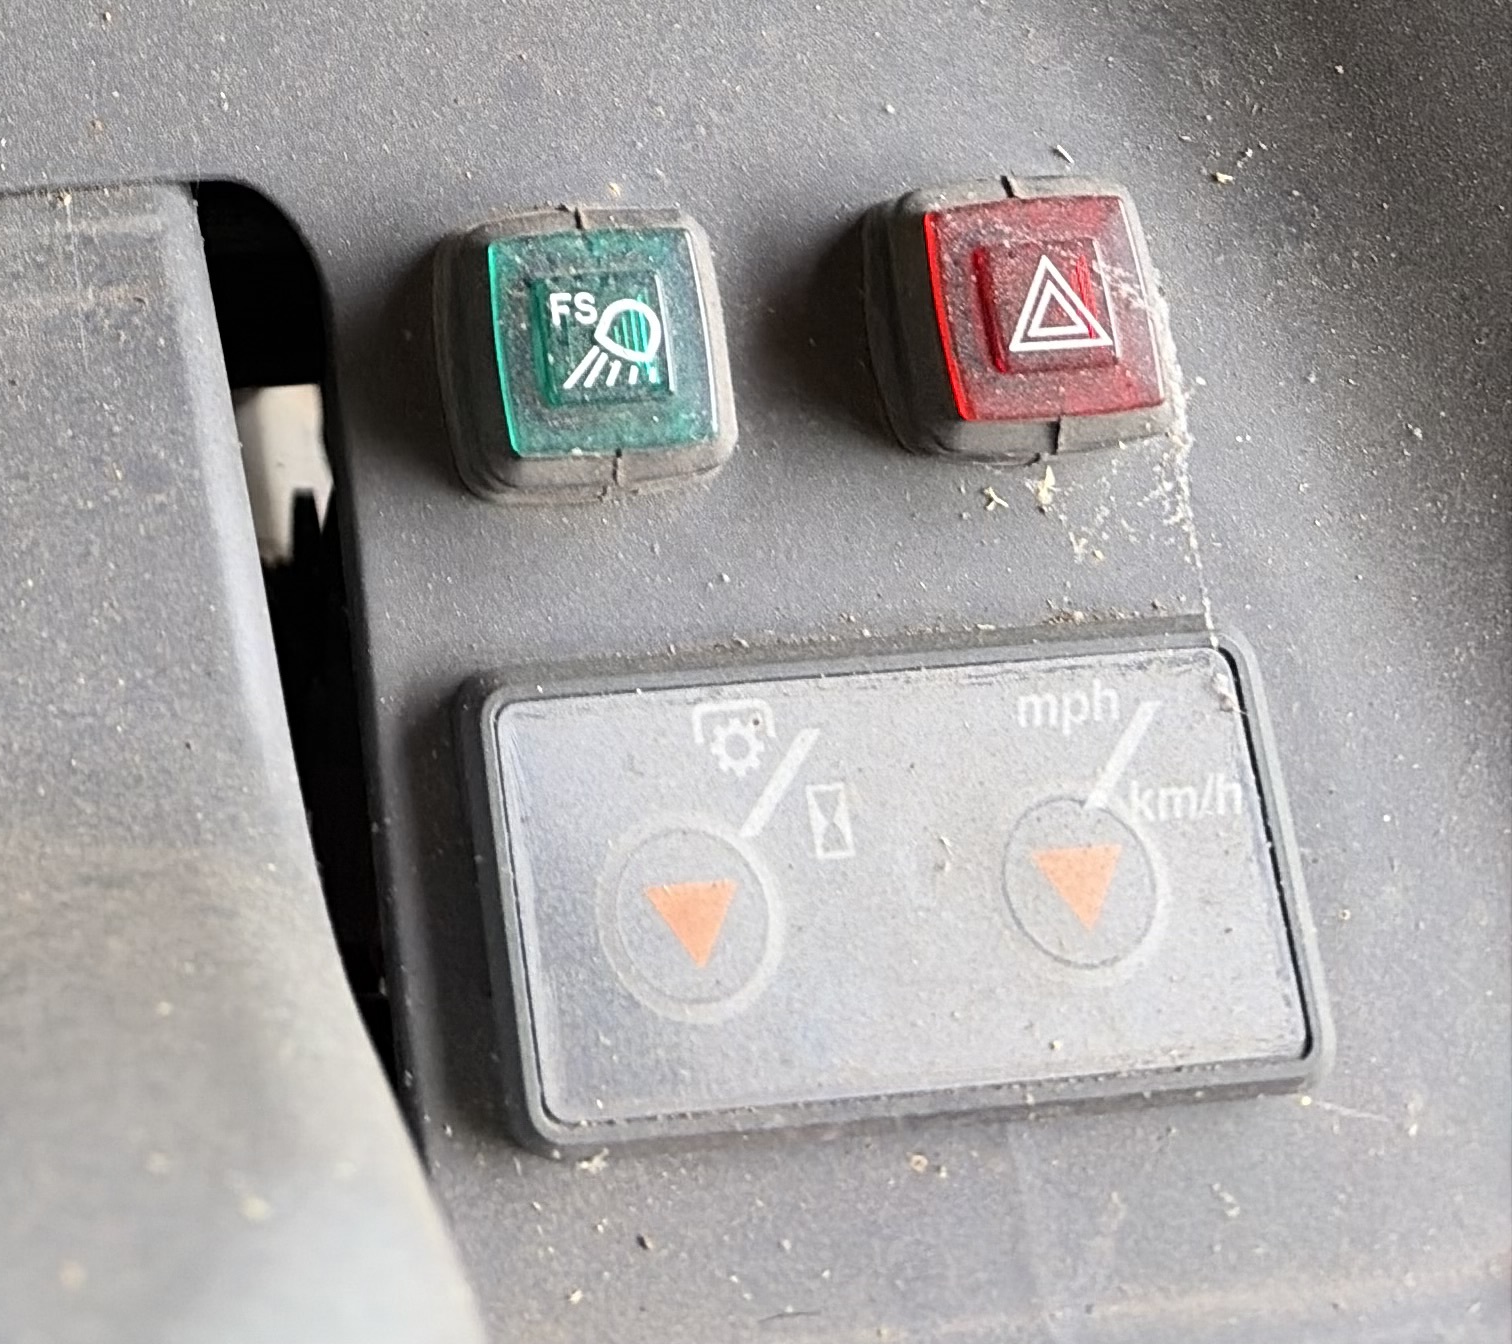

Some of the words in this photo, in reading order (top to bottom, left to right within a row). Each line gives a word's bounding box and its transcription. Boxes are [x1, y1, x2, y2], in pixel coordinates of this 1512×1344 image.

[549, 292, 597, 326] FS
[1017, 677, 1121, 736] mph
[1126, 777, 1244, 820] km/h
